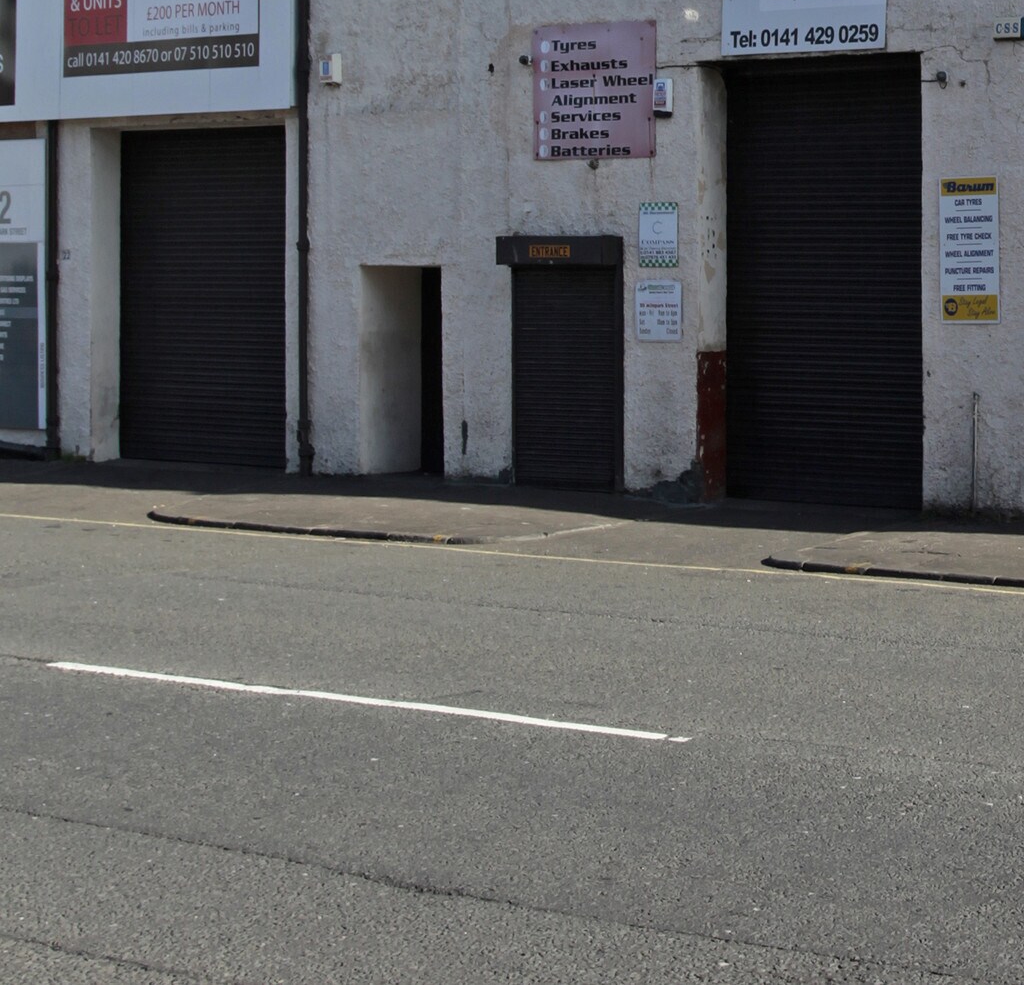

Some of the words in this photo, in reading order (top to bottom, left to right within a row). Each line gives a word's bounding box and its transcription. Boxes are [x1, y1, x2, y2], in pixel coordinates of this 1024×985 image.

[146, 6, 173, 21] £200
[175, 3, 195, 19] PER
[197, 0, 240, 17] MONTH
[69, 18, 89, 37] TO
[96, 16, 121, 36] LET
[142, 26, 180, 38] including
[181, 24, 198, 35] bills
[201, 24, 207, 33] &
[209, 22, 240, 34] parking
[730, 31, 757, 48] Tel:
[761, 28, 799, 47] 0141
[805, 26, 834, 45] 429
[838, 23, 879, 44] 0259
[551, 40, 597, 54] Tyres
[67, 53, 84, 68] call
[86, 51, 110, 66] 0141
[112, 51, 132, 65] 420
[133, 49, 159, 64] 8670
[161, 50, 172, 62] or
[174, 47, 187, 61] 07
[190, 45, 209, 60] 510
[212, 43, 231, 59] 510
[234, 42, 255, 57] 510
[551, 59, 628, 72] Exhausts
[551, 76, 597, 89] Laser
[602, 74, 653, 87] Wheel
[551, 93, 637, 108] Alignment
[551, 111, 621, 123] Services
[551, 128, 610, 140] Brakes
[551, 145, 631, 157] Batteries
[944, 181, 994, 193] Barum
[966, 198, 982, 206] TYRES
[945, 216, 962, 224] WHEEL
[963, 215, 993, 223] BALANCING
[960, 232, 973, 240] TYRE
[531, 246, 568, 256] ENTRANCE
[967, 284, 986, 292] FITTING
